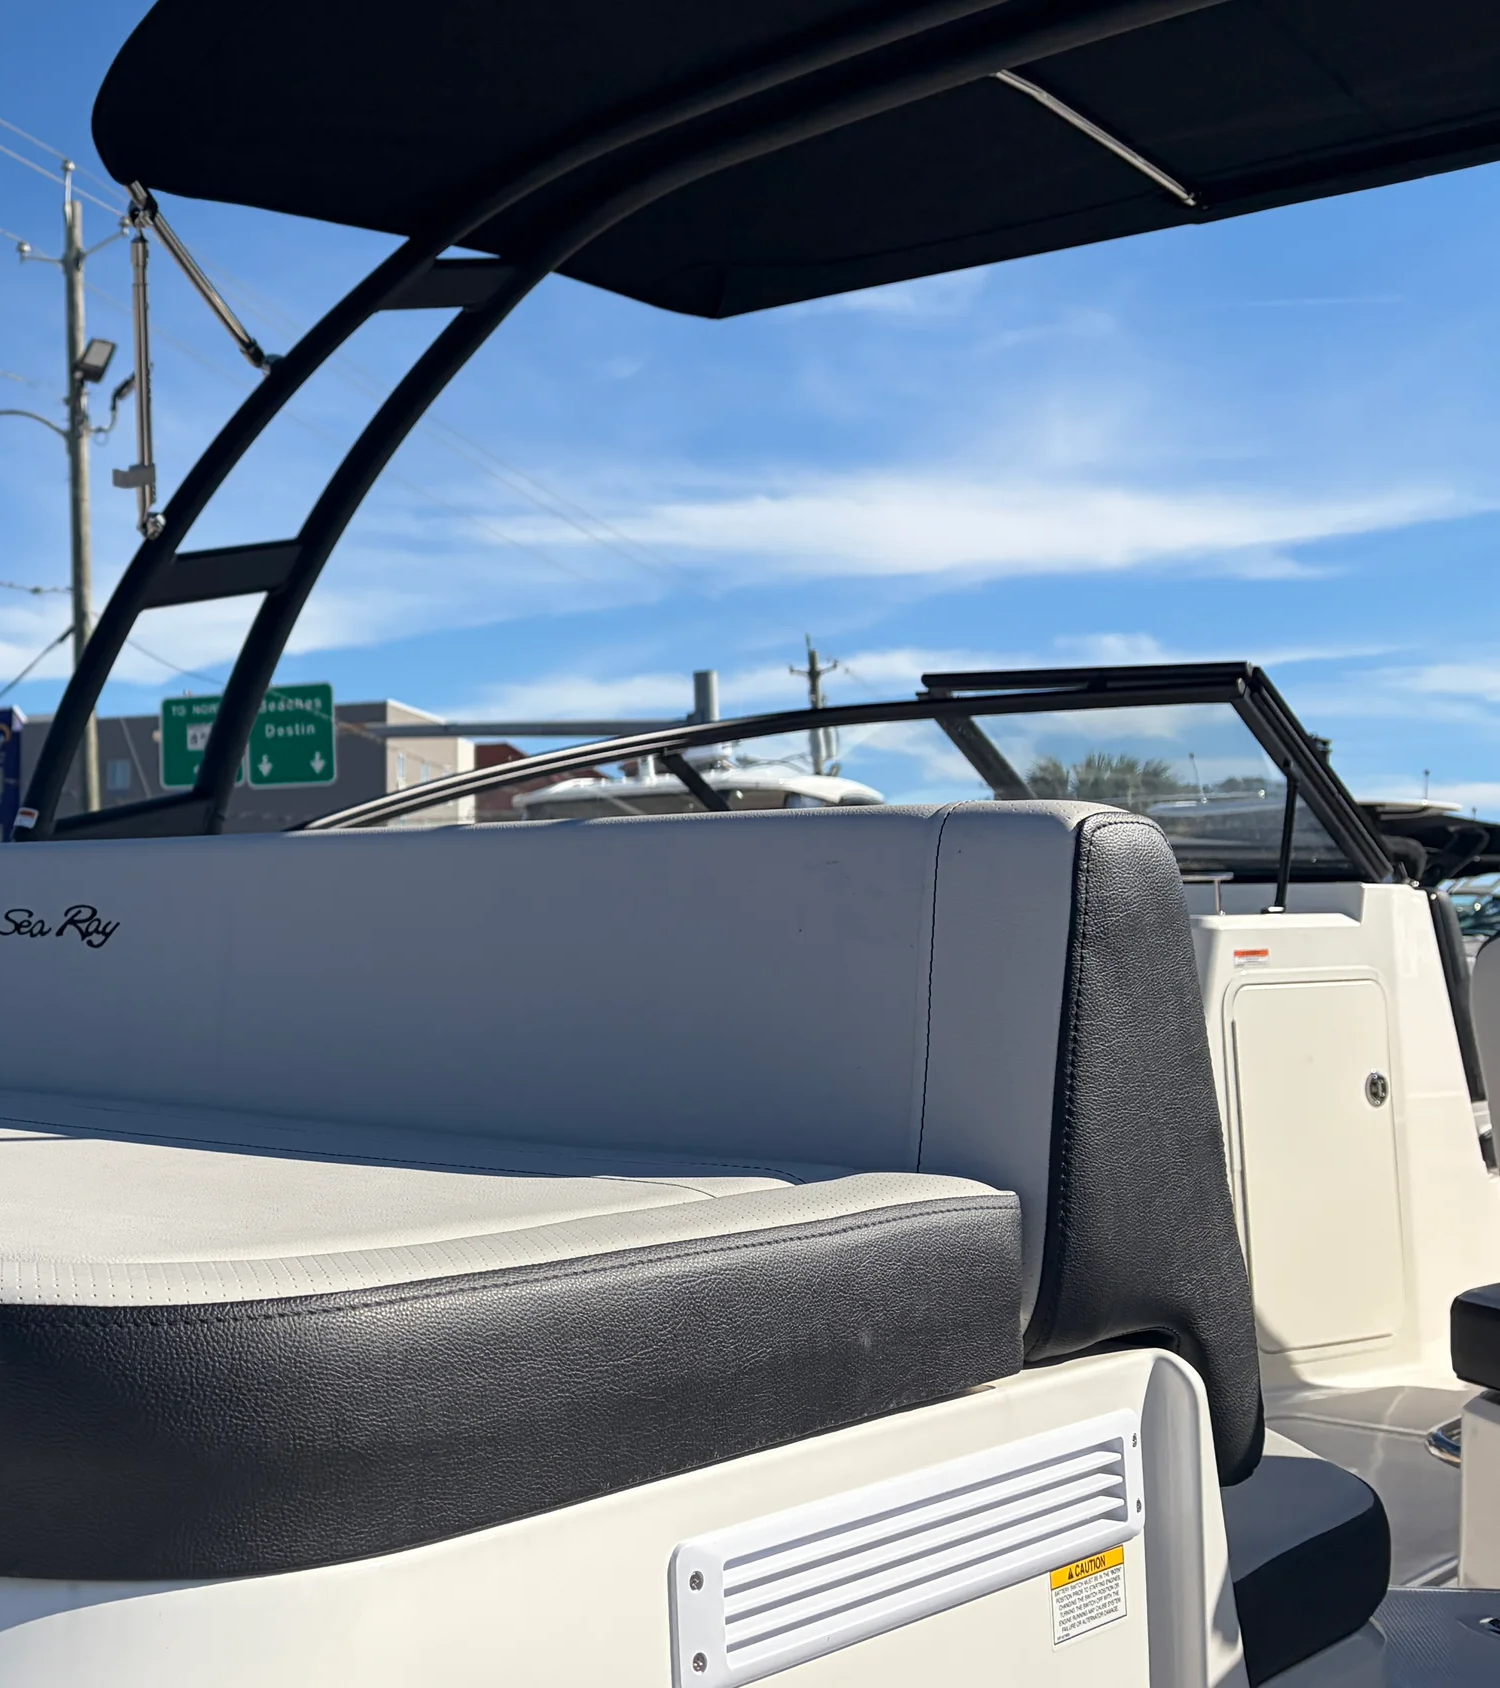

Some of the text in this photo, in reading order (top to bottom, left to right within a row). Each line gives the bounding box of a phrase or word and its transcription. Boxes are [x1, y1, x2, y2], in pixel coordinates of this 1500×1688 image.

[171, 705, 187, 717] TO
[265, 722, 316, 739] Destin
[55, 904, 121, 949] Ray
[1074, 1554, 1105, 1577] CAUTION
[1054, 1586, 1069, 1597] BATTERY
[1070, 1580, 1083, 1591] SWITCH
[1083, 1577, 1093, 1586] MUST
[1055, 1592, 1072, 1604] POSITION
[1072, 1588, 1083, 1598] PRIOR
[1088, 1579, 1105, 1591] STARTING
[1058, 1598, 1076, 1611] CHANGING
[1084, 1590, 1097, 1600] SWITCH
[1098, 1584, 1113, 1595] POSITION
[1058, 1616, 1071, 1626] ENGINE
[1072, 1609, 1087, 1621] RUNNING
[1095, 1602, 1106, 1611] CAUSE
[1107, 1596, 1120, 1607] SYSTEM
[1059, 1606, 1074, 1618] TURNING
[1083, 1598, 1095, 1609] SWITCH
[1103, 1592, 1112, 1601] WITH
[1061, 1622, 1075, 1633] FAILURE
[1076, 1619, 1081, 1627] OR
